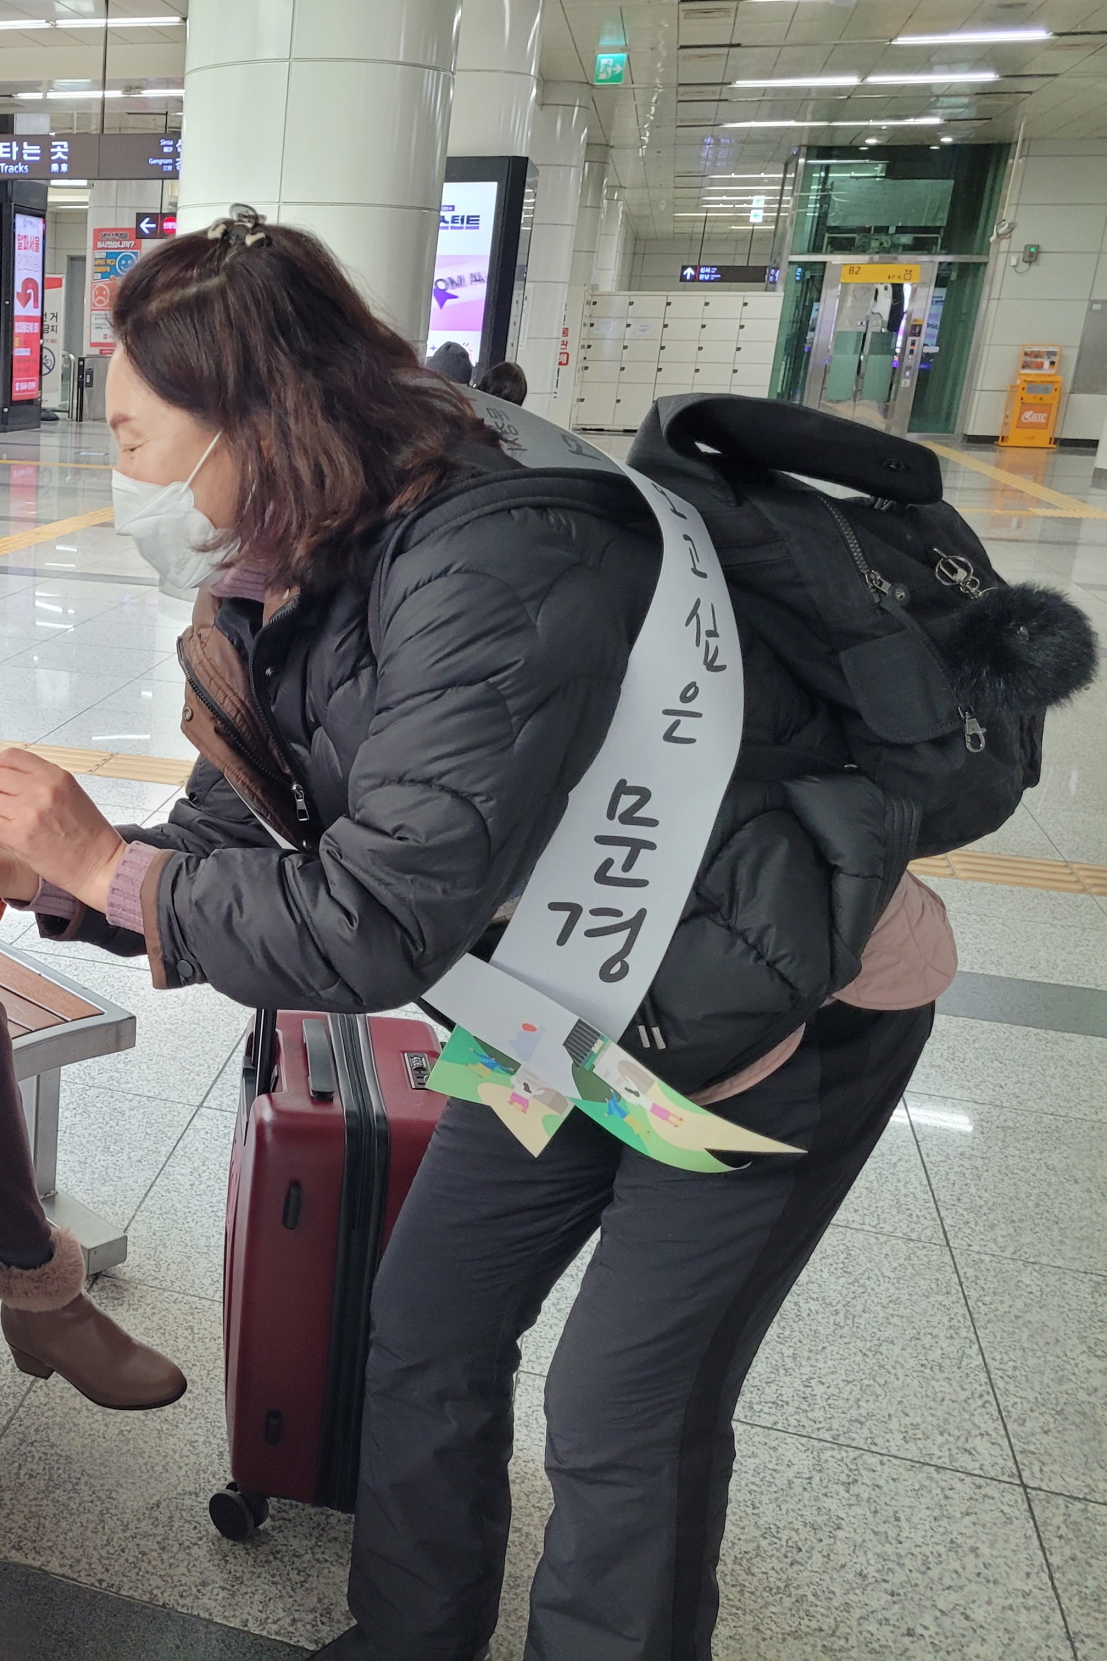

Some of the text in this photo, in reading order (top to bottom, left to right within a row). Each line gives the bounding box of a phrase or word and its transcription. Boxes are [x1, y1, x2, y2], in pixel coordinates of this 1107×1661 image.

[50, 141, 69, 160] 곳
[0, 163, 29, 174] Tracks
[848, 266, 861, 275] B2
